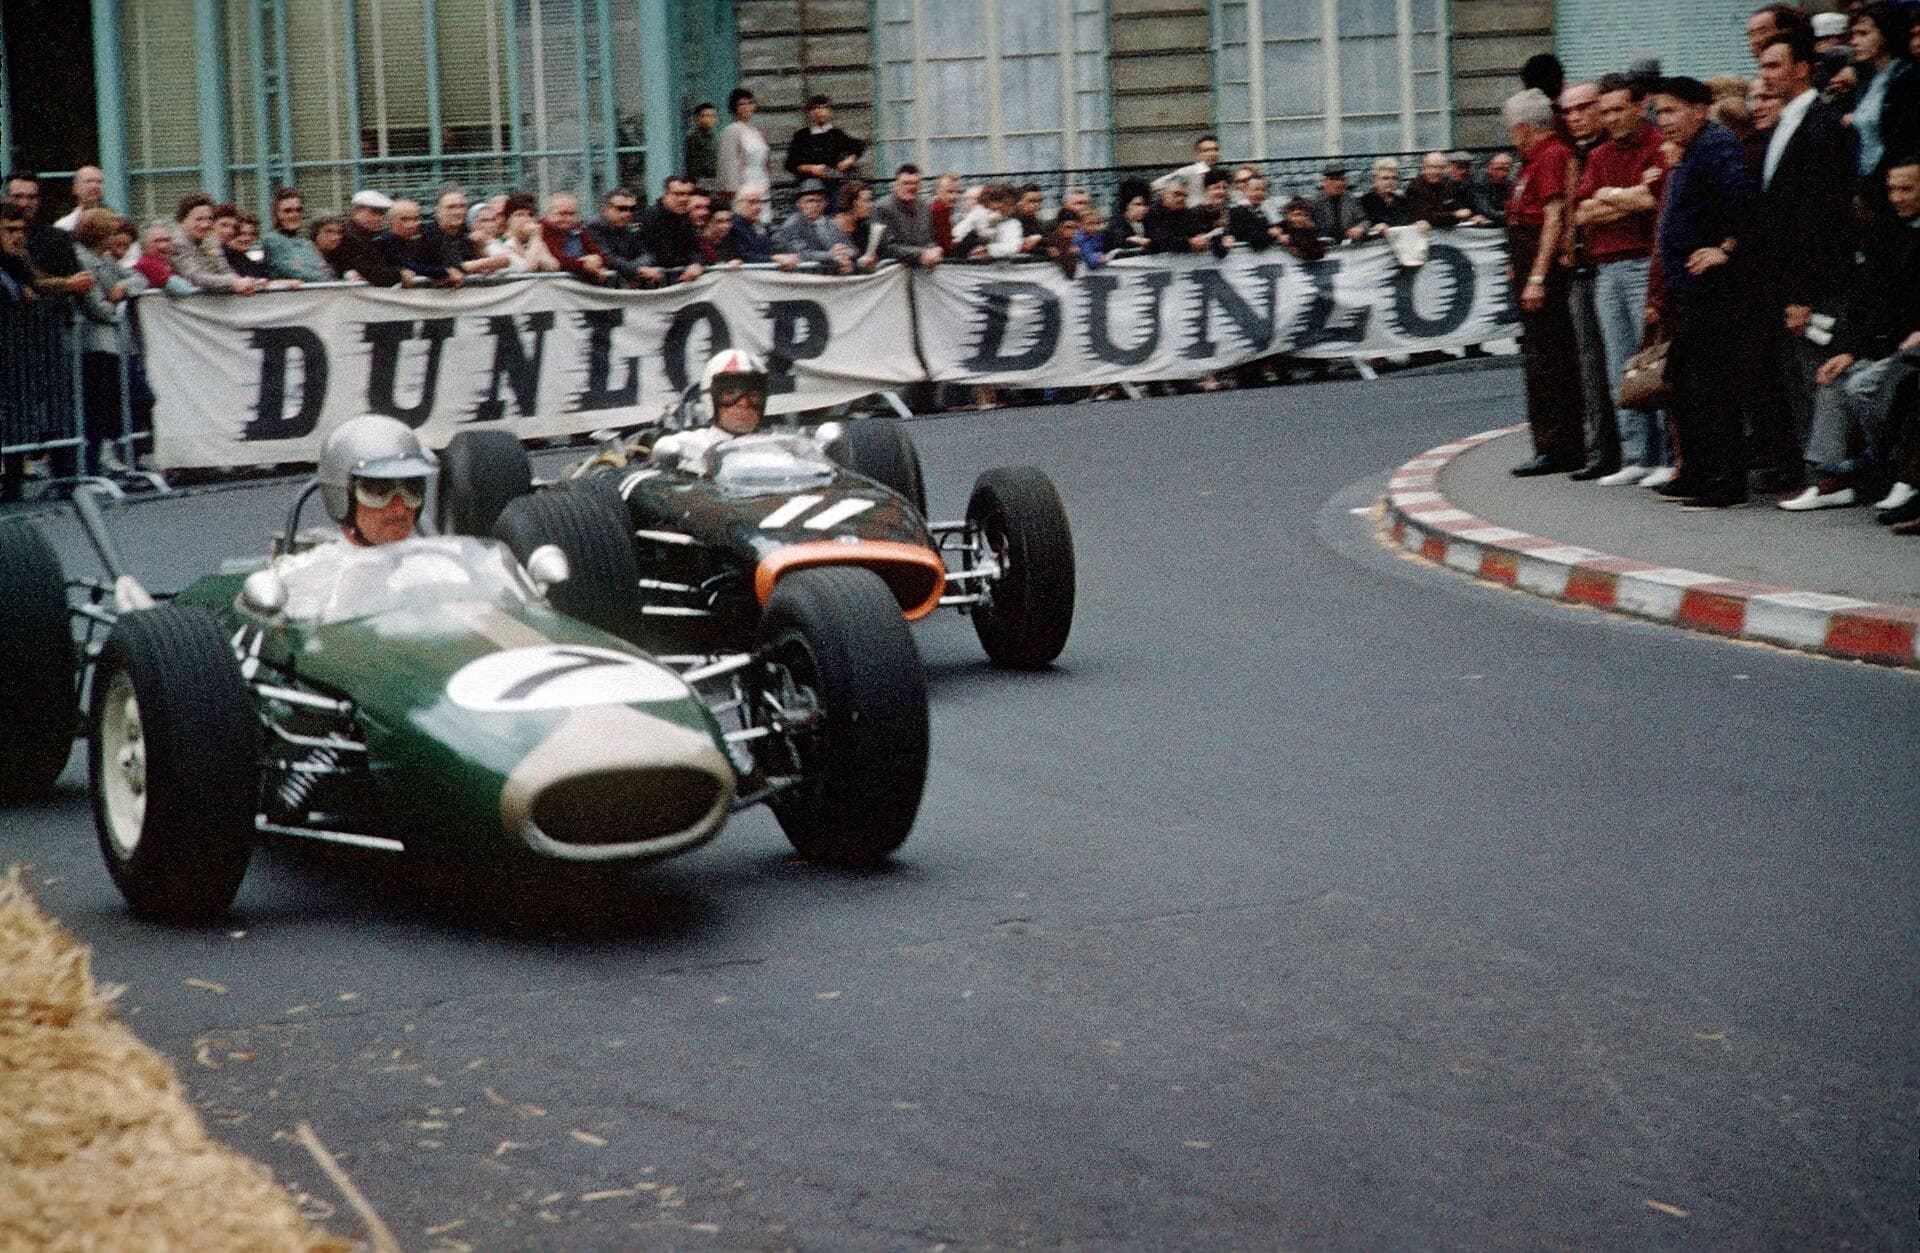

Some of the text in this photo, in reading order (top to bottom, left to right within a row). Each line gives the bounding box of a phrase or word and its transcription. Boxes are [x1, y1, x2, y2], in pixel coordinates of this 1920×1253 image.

[958, 244, 1520, 373] DUNLO
[235, 299, 829, 441] DUNLOP
[758, 495, 875, 530] 11
[497, 650, 634, 701] 7
